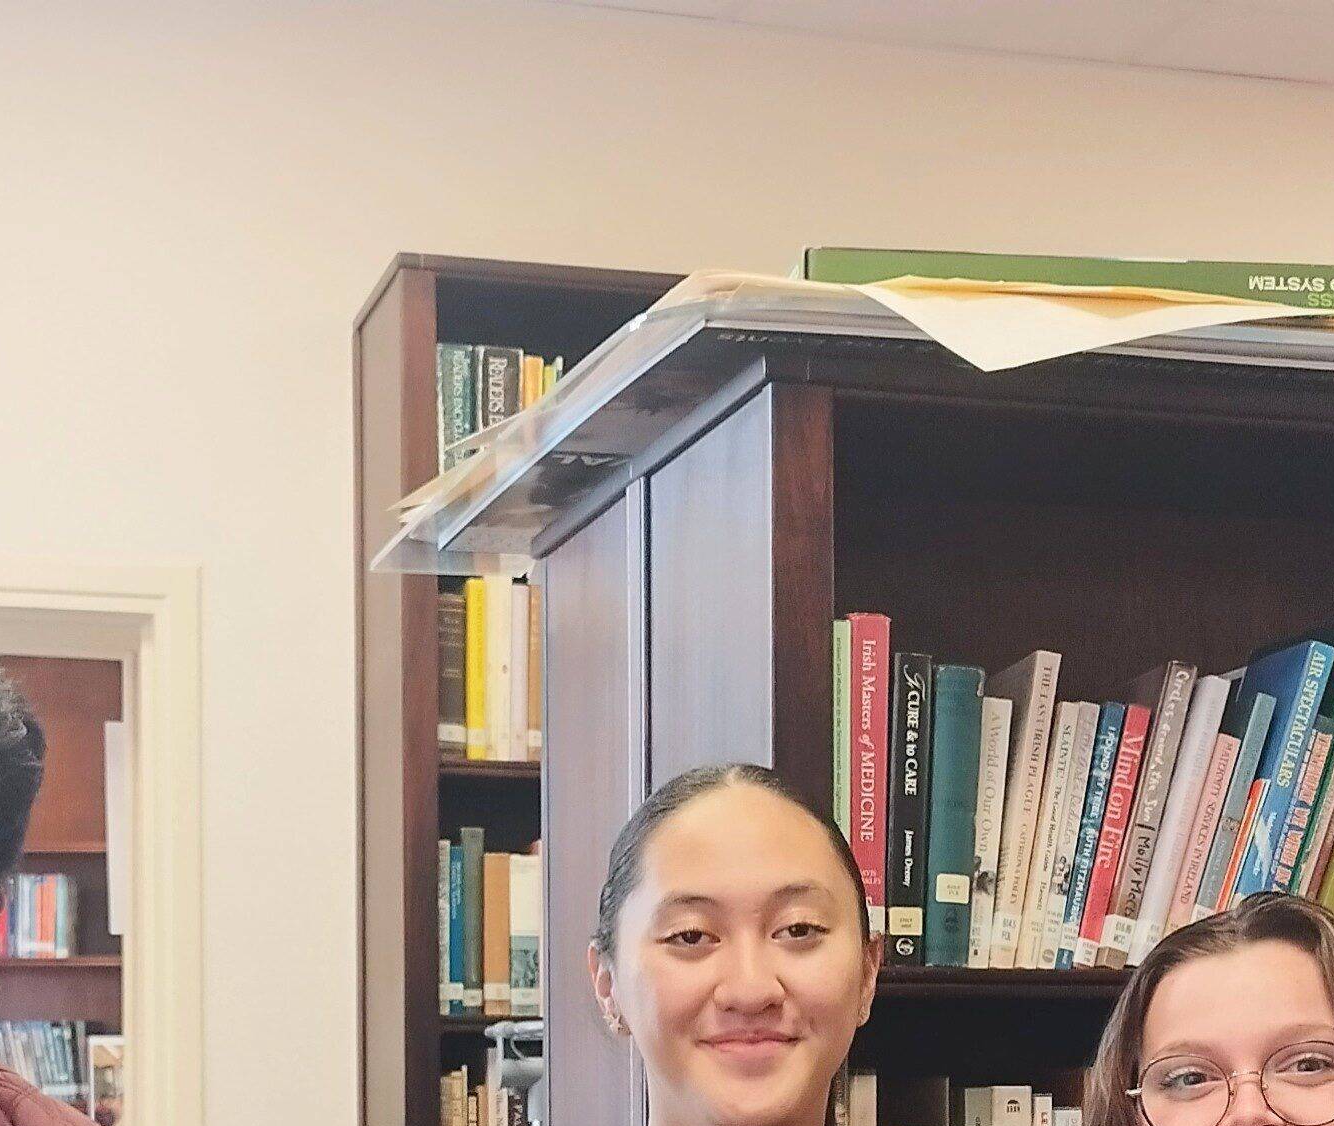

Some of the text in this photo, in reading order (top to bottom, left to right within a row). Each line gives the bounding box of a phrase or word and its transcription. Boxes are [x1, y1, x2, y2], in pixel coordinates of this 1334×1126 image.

[1248, 276, 1324, 292] SYSTEM
[1040, 664, 1054, 686] THE
[857, 639, 877, 842] Irish Masters of MEDICINE
[1275, 651, 1327, 788] AIR SPECTACULARS
[904, 691, 920, 797] CURE & to CARE
[986, 725, 1004, 769] World
[1028, 725, 1044, 763] IRISH
[985, 771, 1001, 785] of
[1021, 765, 1039, 815] PLAGUE
[1132, 669, 1189, 874] Circles the Sun Molly
[1209, 741, 1235, 798] MATERNITY
[982, 786, 999, 815] Our
[1045, 785, 1063, 848] The Good Health
[1097, 733, 1145, 868] Mind on Fire
[978, 817, 995, 853] Own
[1194, 801, 1219, 849] SERVICES
[1179, 859, 1202, 905] IRELAND
